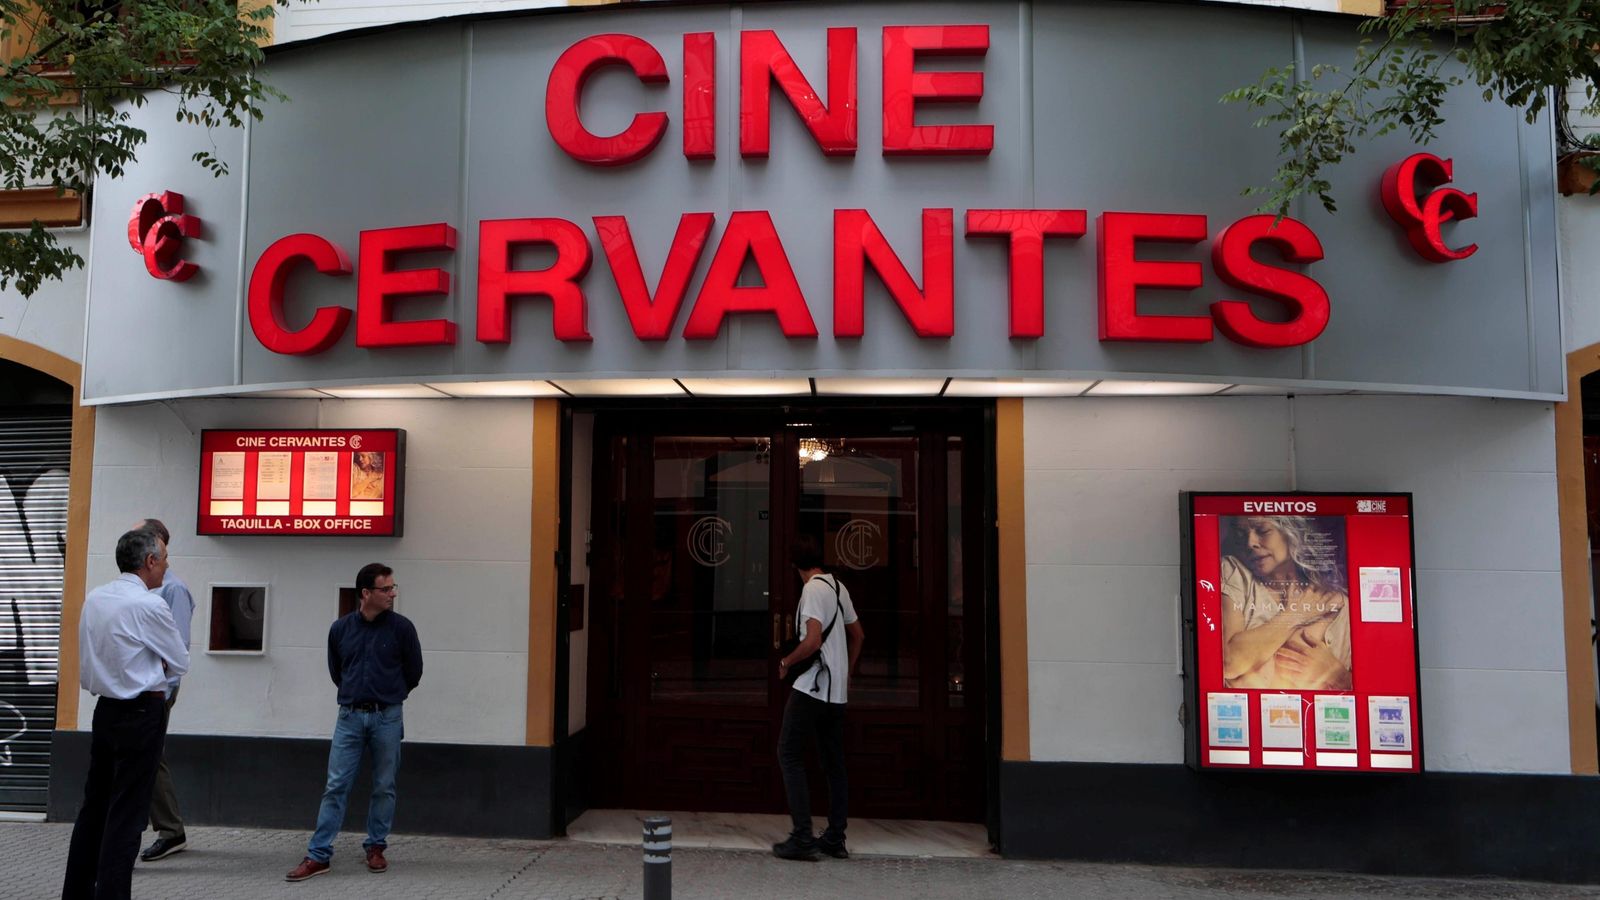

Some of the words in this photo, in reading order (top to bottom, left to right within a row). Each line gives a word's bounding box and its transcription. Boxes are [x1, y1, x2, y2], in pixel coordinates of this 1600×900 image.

[545, 25, 994, 167] CINE
[248, 208, 1331, 355] CERVANTES
[236, 437, 266, 447] CINE
[269, 436, 346, 447] CERVANTES
[1243, 501, 1317, 513] EVENTOS
[1371, 502, 1386, 511] CINE
[221, 519, 281, 529] TAQUILLA
[294, 519, 321, 530] BOX
[324, 519, 372, 530] OFFICE
[1233, 602, 1339, 613] MAMACRUZ
